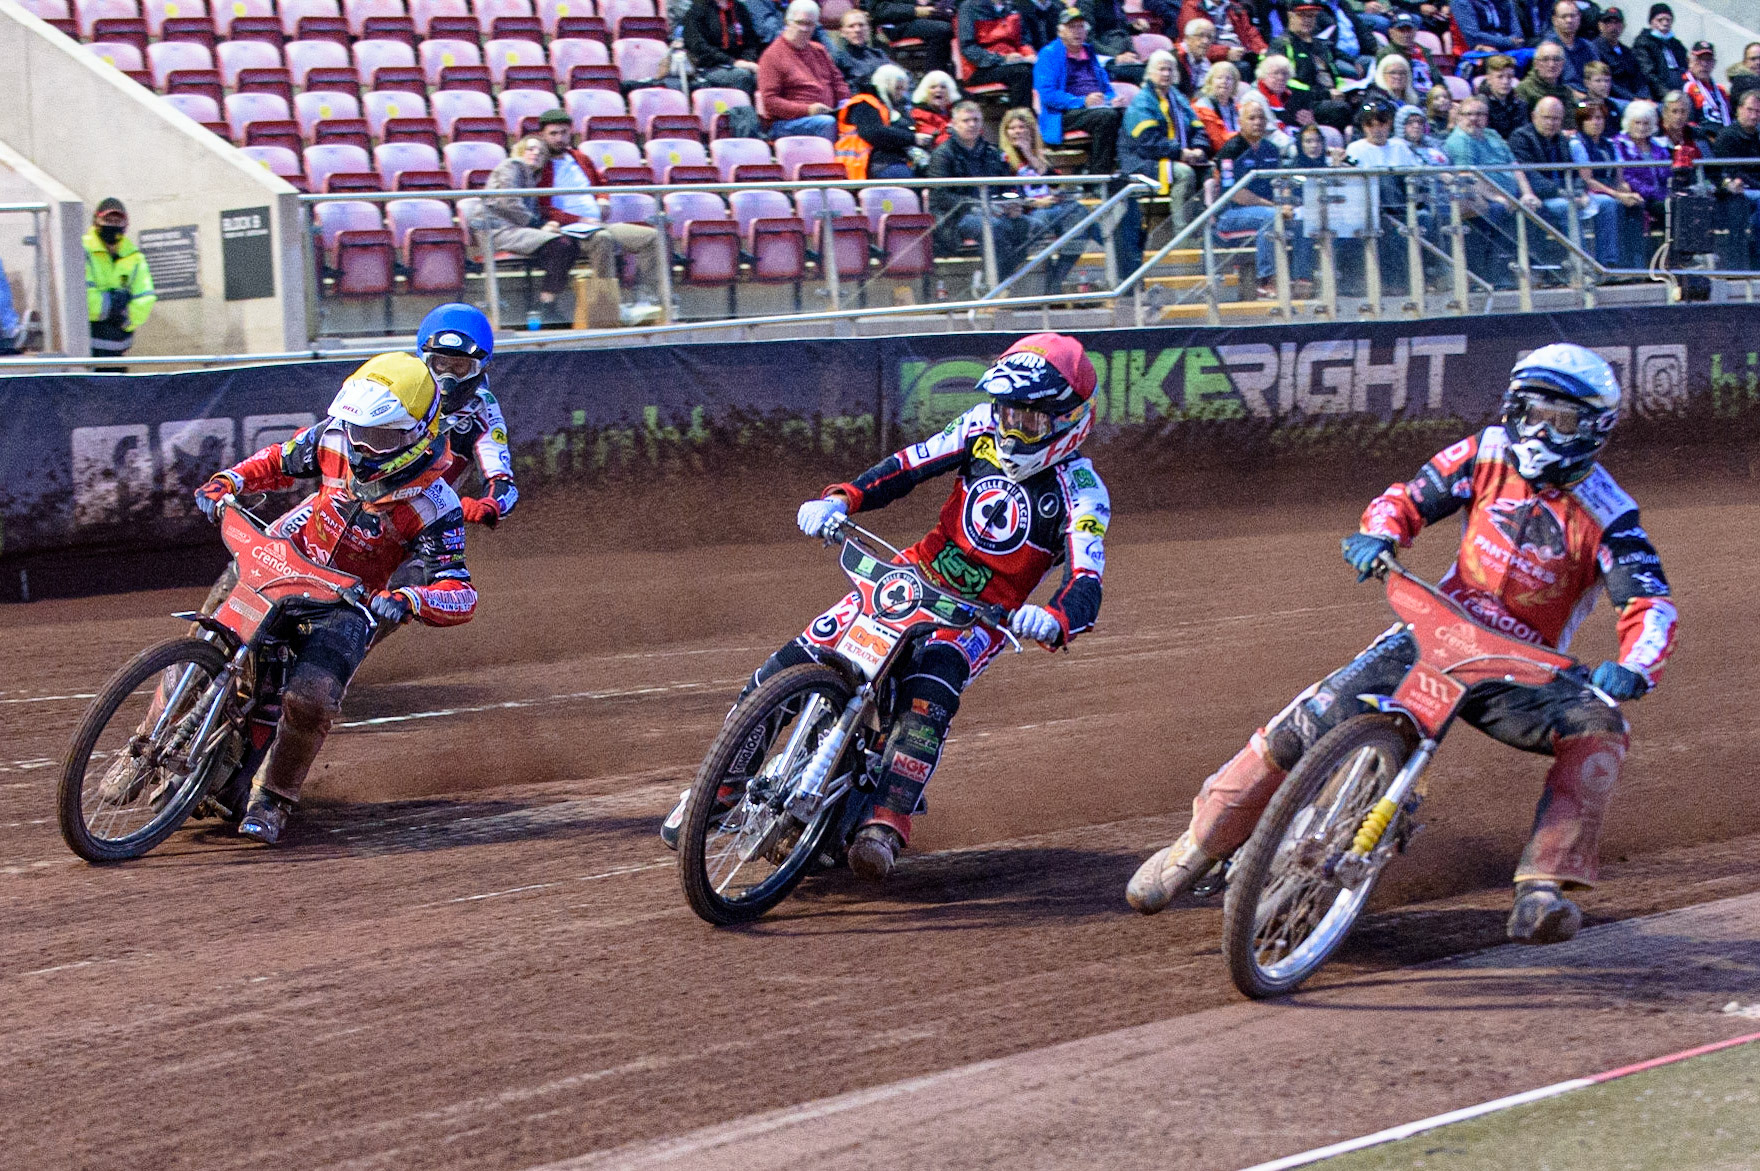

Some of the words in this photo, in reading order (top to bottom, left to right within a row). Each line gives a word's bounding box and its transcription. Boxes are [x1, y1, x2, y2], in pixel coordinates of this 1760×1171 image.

[343, 405, 359, 415] BELL
[976, 480, 1003, 493] BELLE
[1019, 503, 1027, 529] ACES
[251, 546, 302, 582] Crendon
[894, 755, 929, 776] NGK
